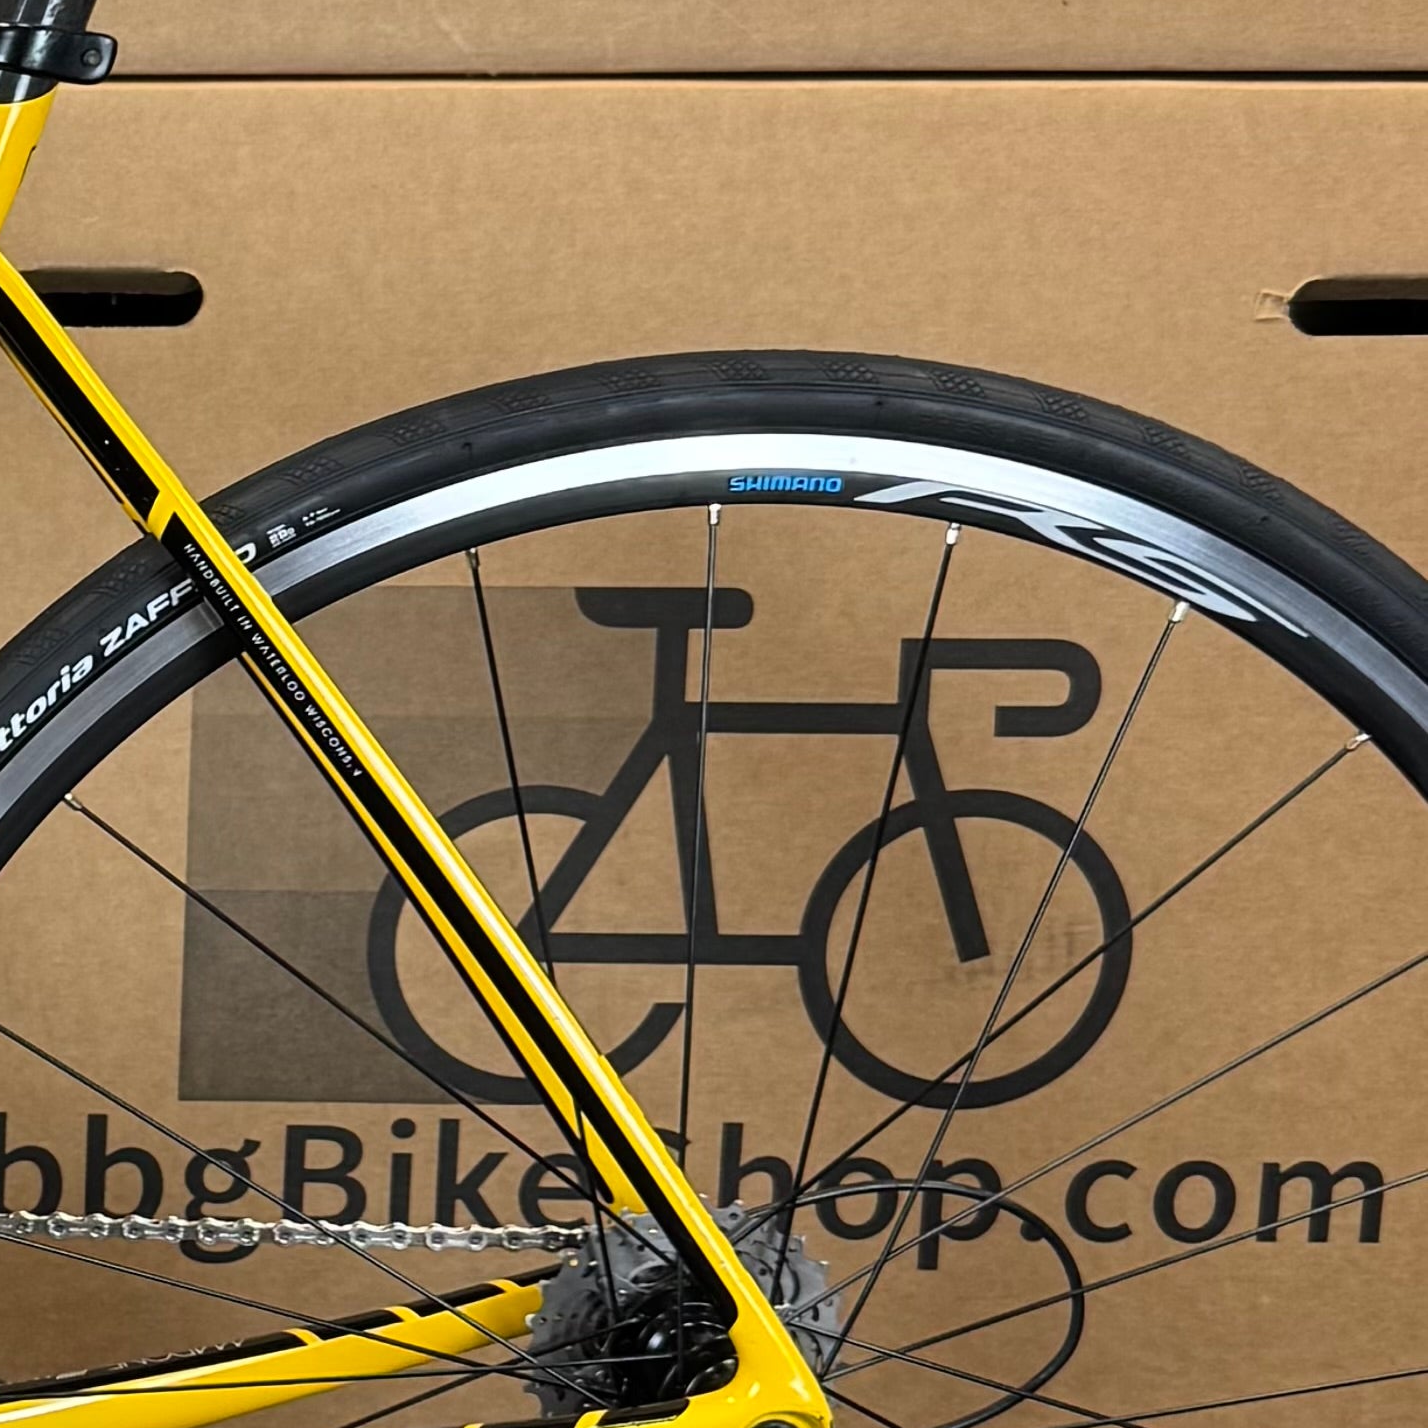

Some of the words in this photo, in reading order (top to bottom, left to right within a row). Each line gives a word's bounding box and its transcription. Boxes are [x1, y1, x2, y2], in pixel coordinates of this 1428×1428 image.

[728, 473, 843, 494] SHIMANO
[183, 543, 240, 613] HANDBUILT
[251, 632, 306, 701] WATERLOO
